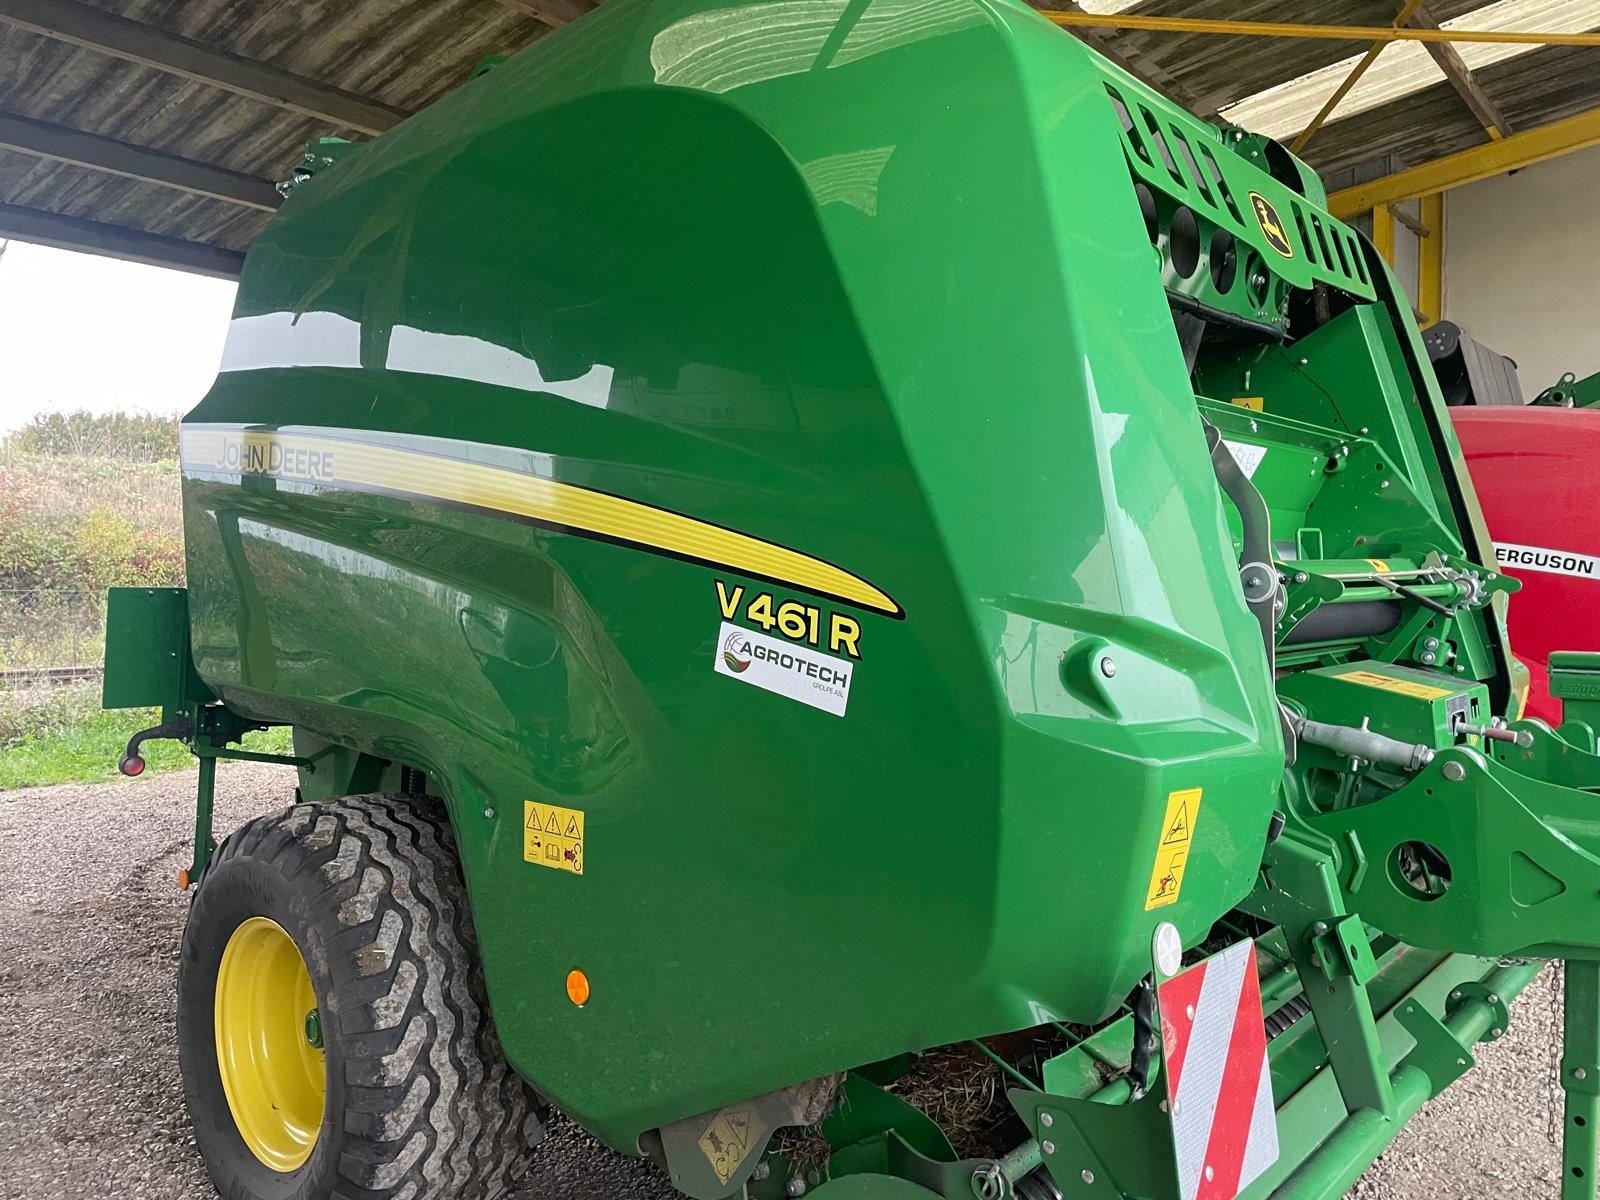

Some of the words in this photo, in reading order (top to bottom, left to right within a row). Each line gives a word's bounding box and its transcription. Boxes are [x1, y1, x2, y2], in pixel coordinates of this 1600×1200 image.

[215, 437, 264, 471] JOHN
[268, 440, 336, 479] DEERE
[714, 579, 745, 620] V
[746, 592, 820, 646] 461
[829, 611, 861, 659] R
[740, 641, 848, 688] AGROTECH
[813, 682, 834, 695] GROUPE
